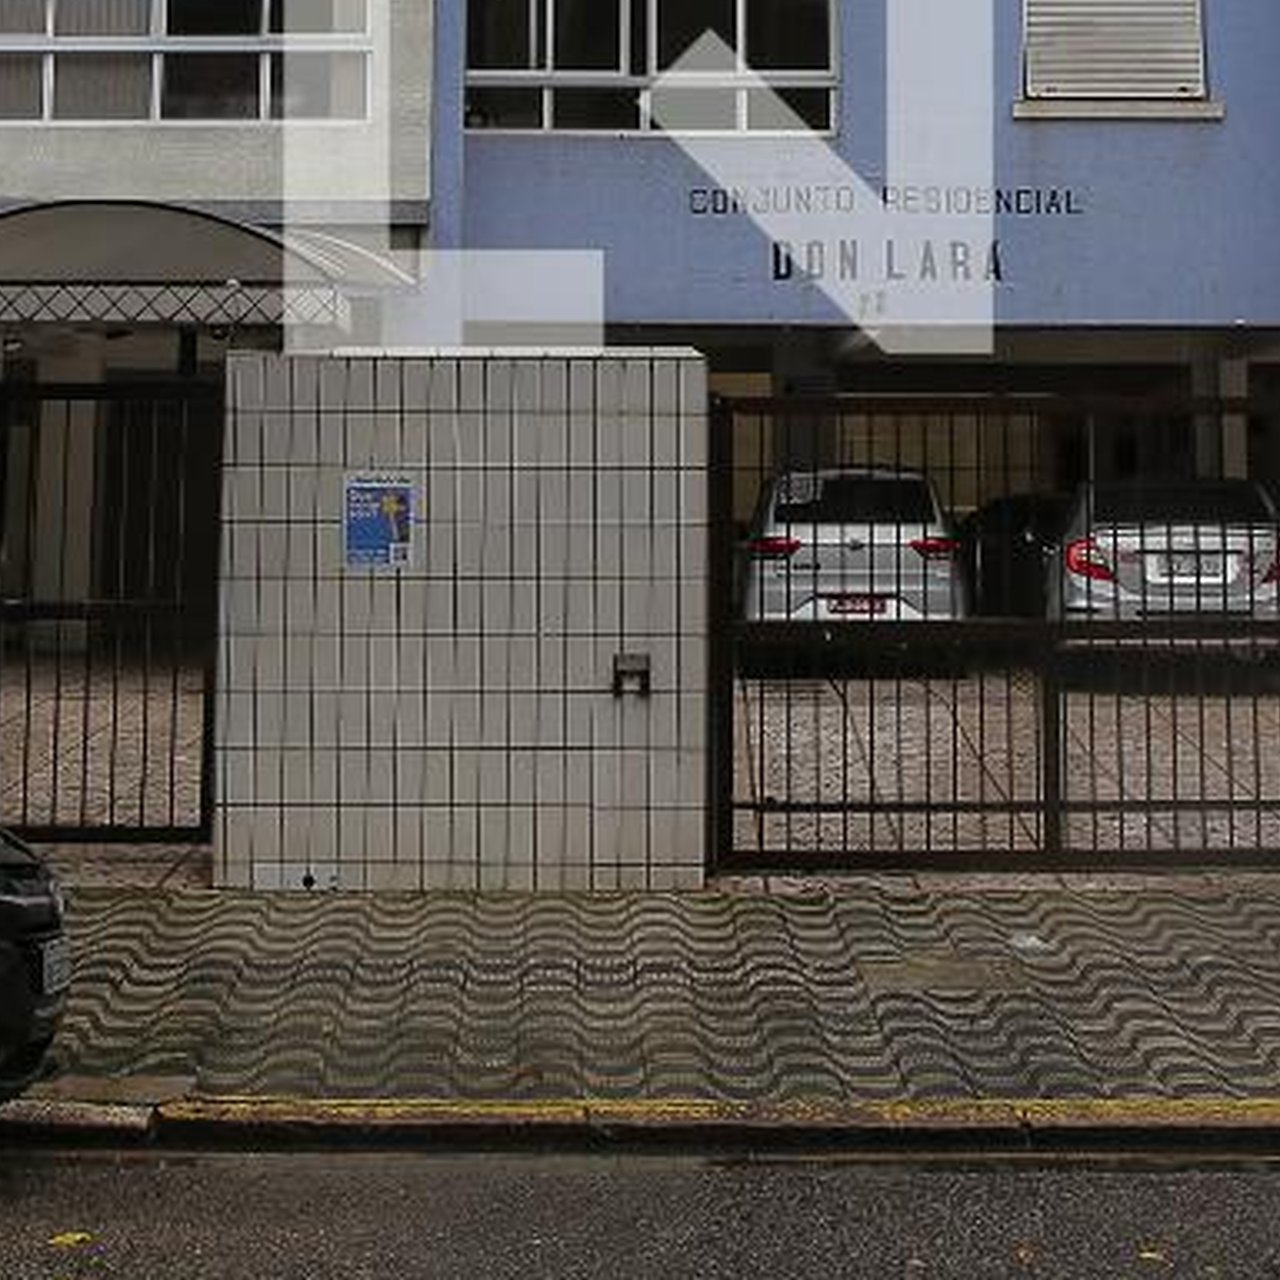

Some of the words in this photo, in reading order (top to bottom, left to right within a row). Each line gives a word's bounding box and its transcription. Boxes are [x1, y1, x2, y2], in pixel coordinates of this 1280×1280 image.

[689, 187, 855, 214] CONJUNTO
[882, 186, 1084, 214] RESIDENCIAL
[772, 239, 858, 281] DON
[886, 239, 1003, 281] LARA
